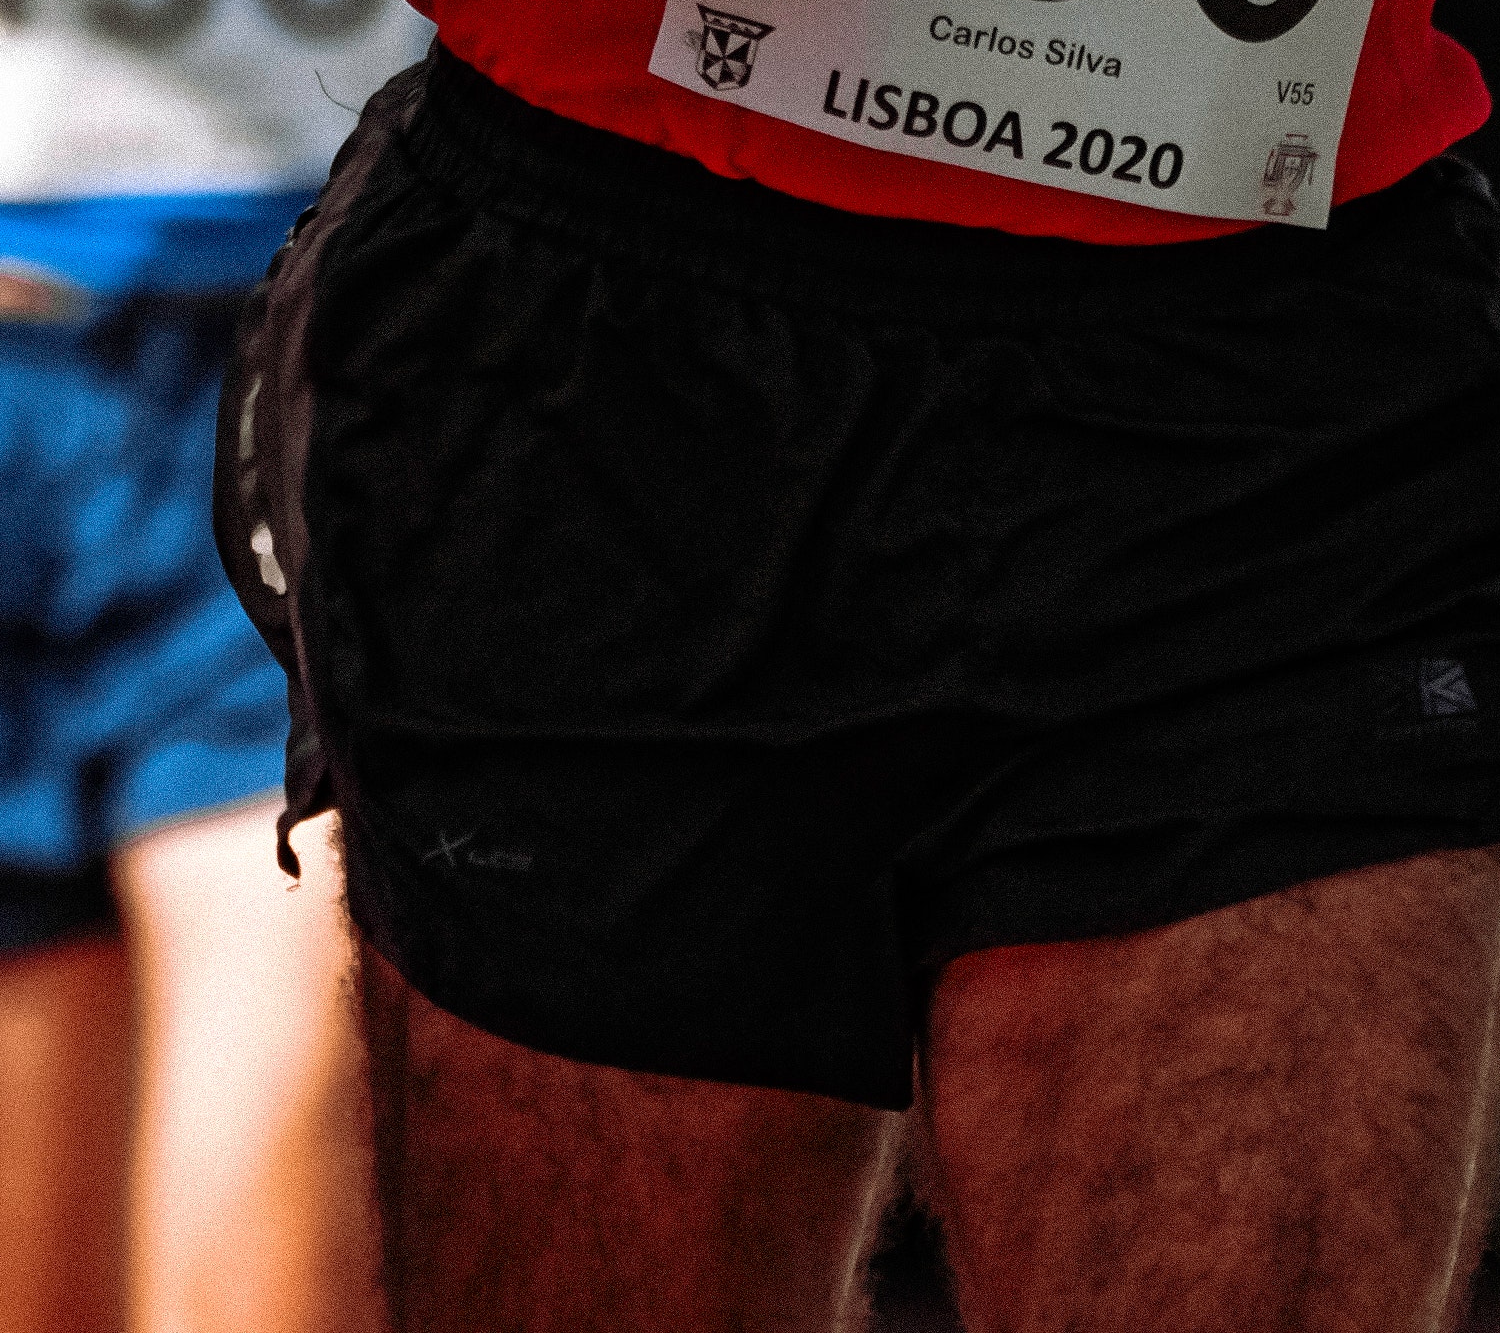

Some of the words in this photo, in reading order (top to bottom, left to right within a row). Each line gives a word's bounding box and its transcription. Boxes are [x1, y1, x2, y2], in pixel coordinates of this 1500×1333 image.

[928, 13, 1036, 61] Carlos
[1044, 37, 1124, 80] Silva
[1276, 80, 1317, 107] V55
[822, 68, 1027, 161] LISBOA
[1042, 120, 1186, 191] 2020
